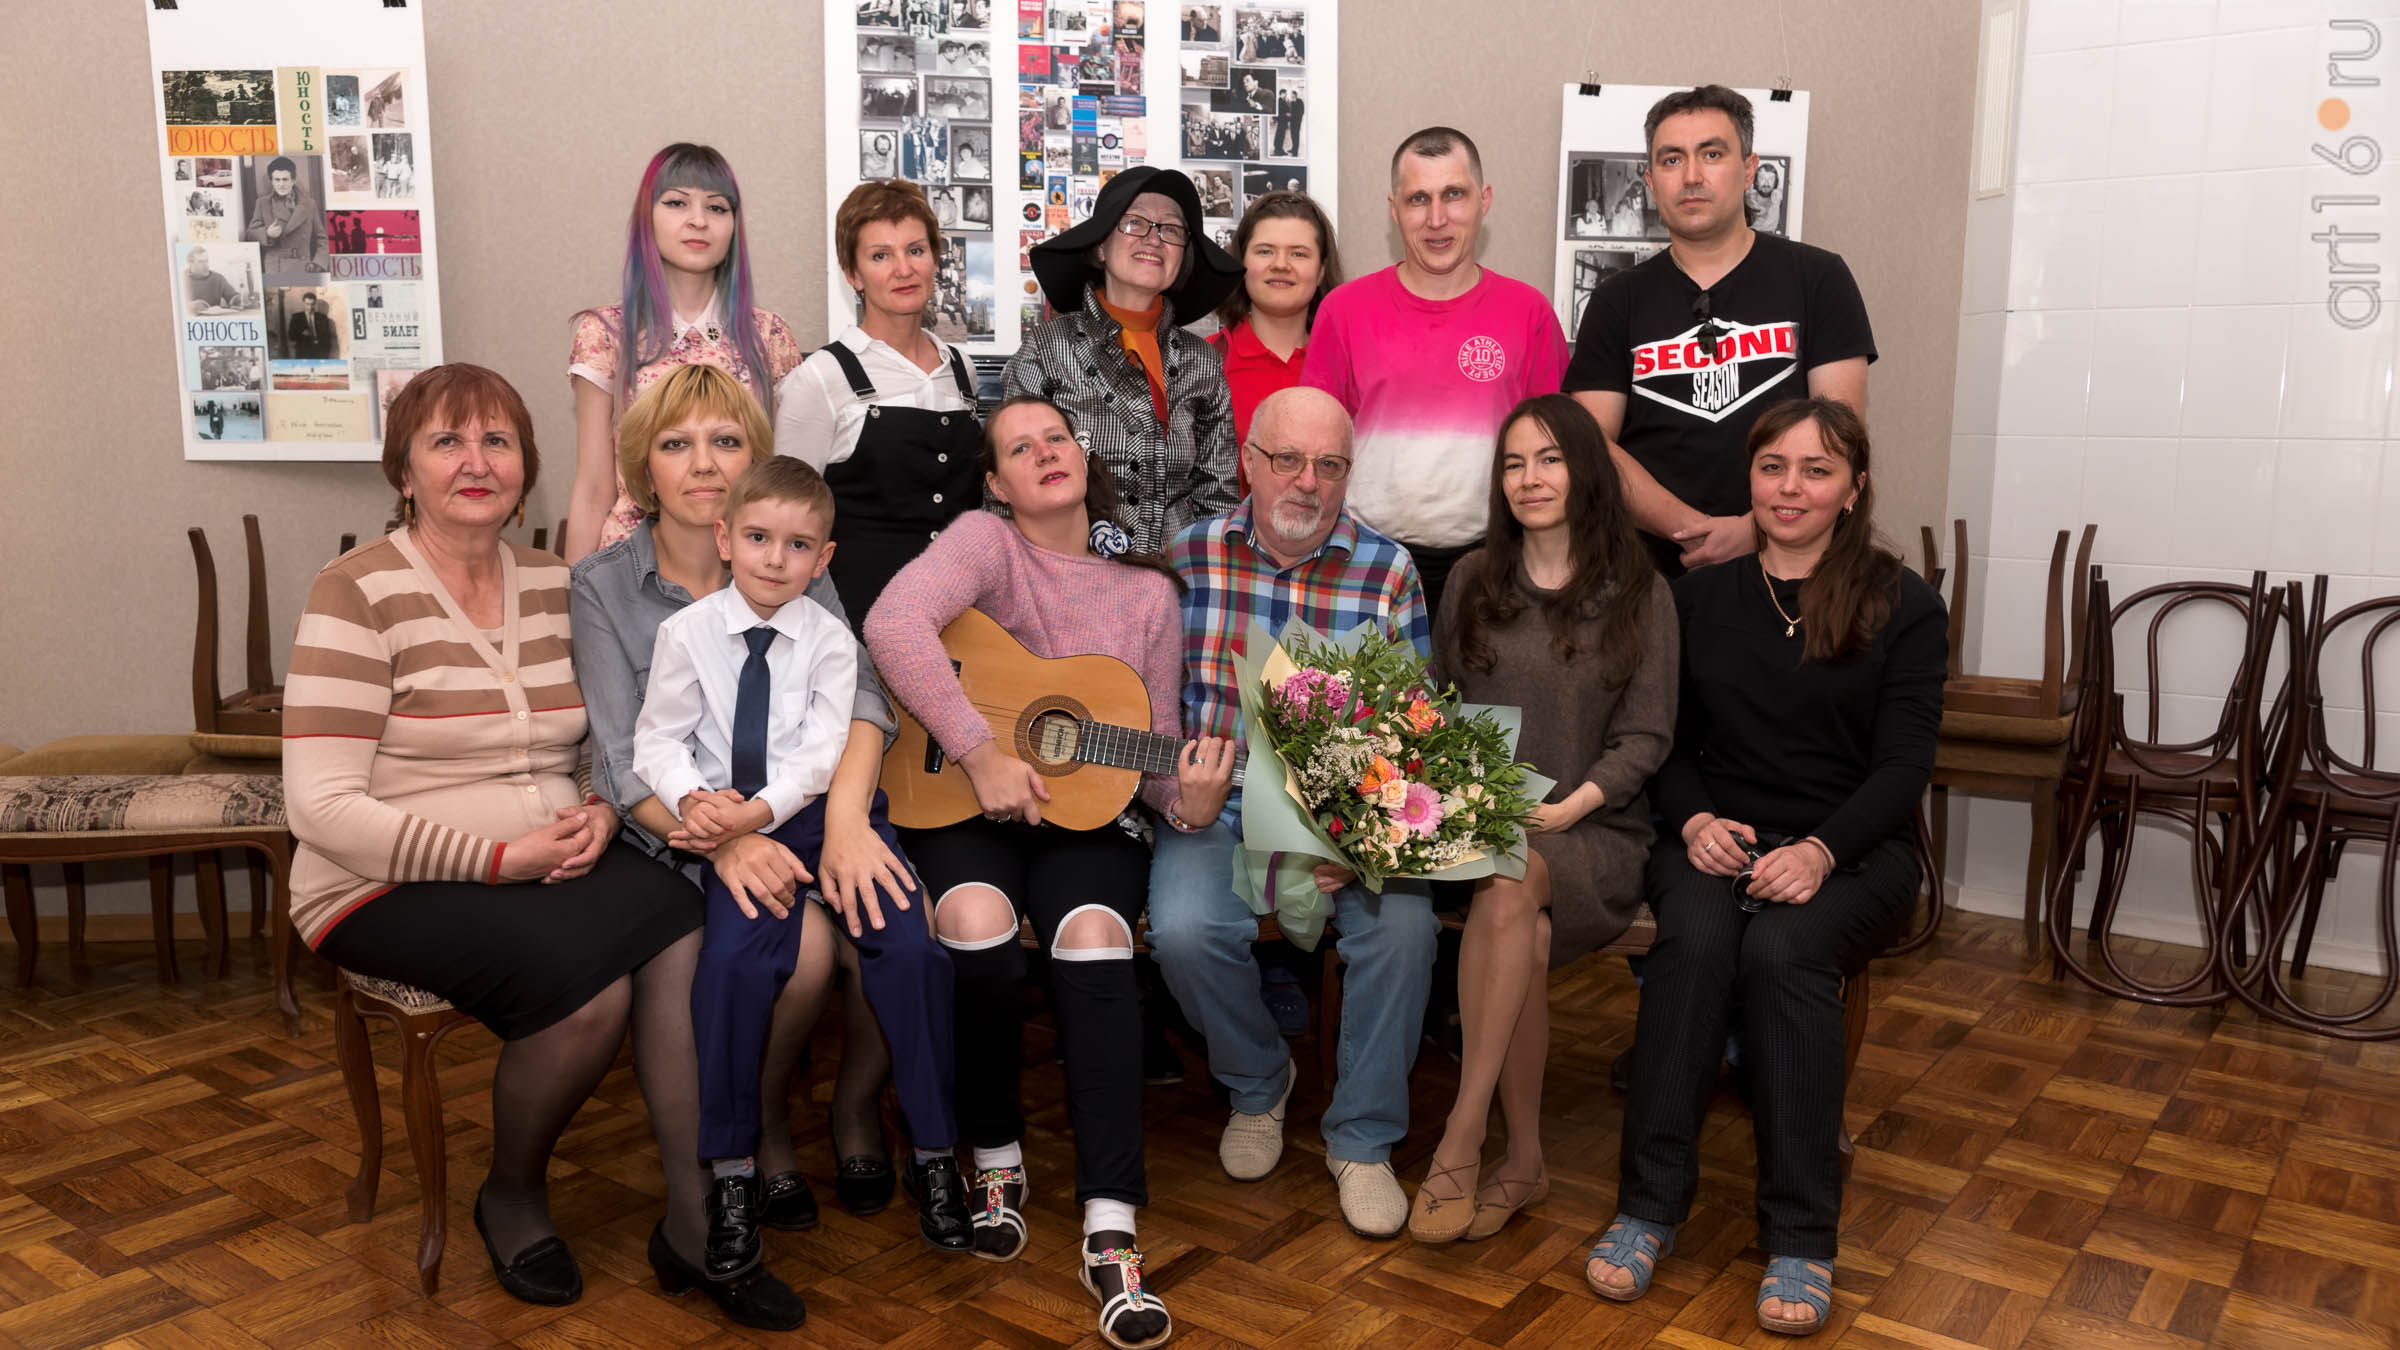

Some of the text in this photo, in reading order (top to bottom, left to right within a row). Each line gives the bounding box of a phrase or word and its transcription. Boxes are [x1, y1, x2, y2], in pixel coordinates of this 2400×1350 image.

[295, 71, 313, 151] ЮНОСТЬ
[168, 127, 275, 153] ЮНОСТЬ
[331, 255, 422, 279] ЮНОСТЬ
[187, 321, 259, 342] ЮНОСТЬ
[382, 325, 419, 337] БИЛЕТ
[1460, 343, 1473, 367] NIKE
[1473, 338, 1503, 370] ATHLETIC
[1474, 348, 1491, 362] 10
[1633, 326, 1797, 376] SECOND
[1692, 362, 1740, 411] SEASON
